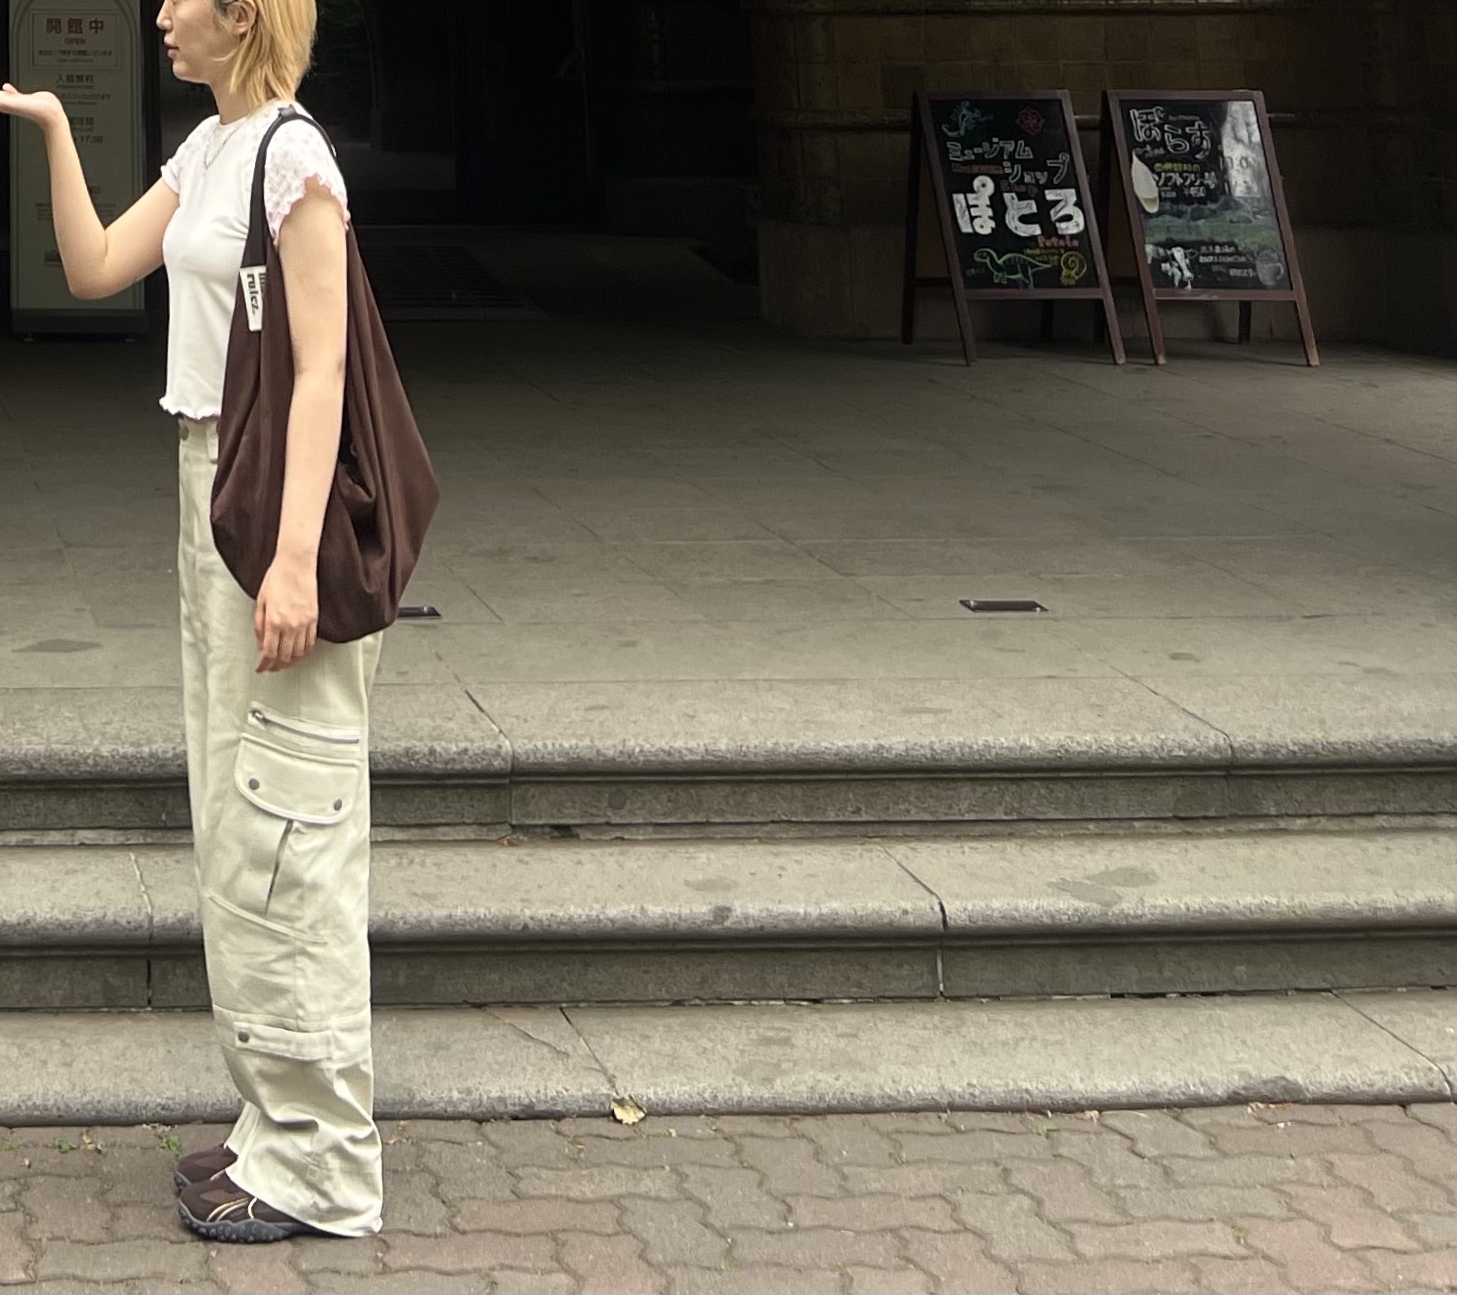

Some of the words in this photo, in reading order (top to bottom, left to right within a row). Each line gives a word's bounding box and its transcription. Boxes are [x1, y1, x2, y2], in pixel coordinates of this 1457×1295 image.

[46, 17, 104, 35] 開館中
[946, 137, 1034, 162] ミュージアム
[1002, 152, 1070, 184] ショップ
[952, 175, 1085, 237] ぽとろ
